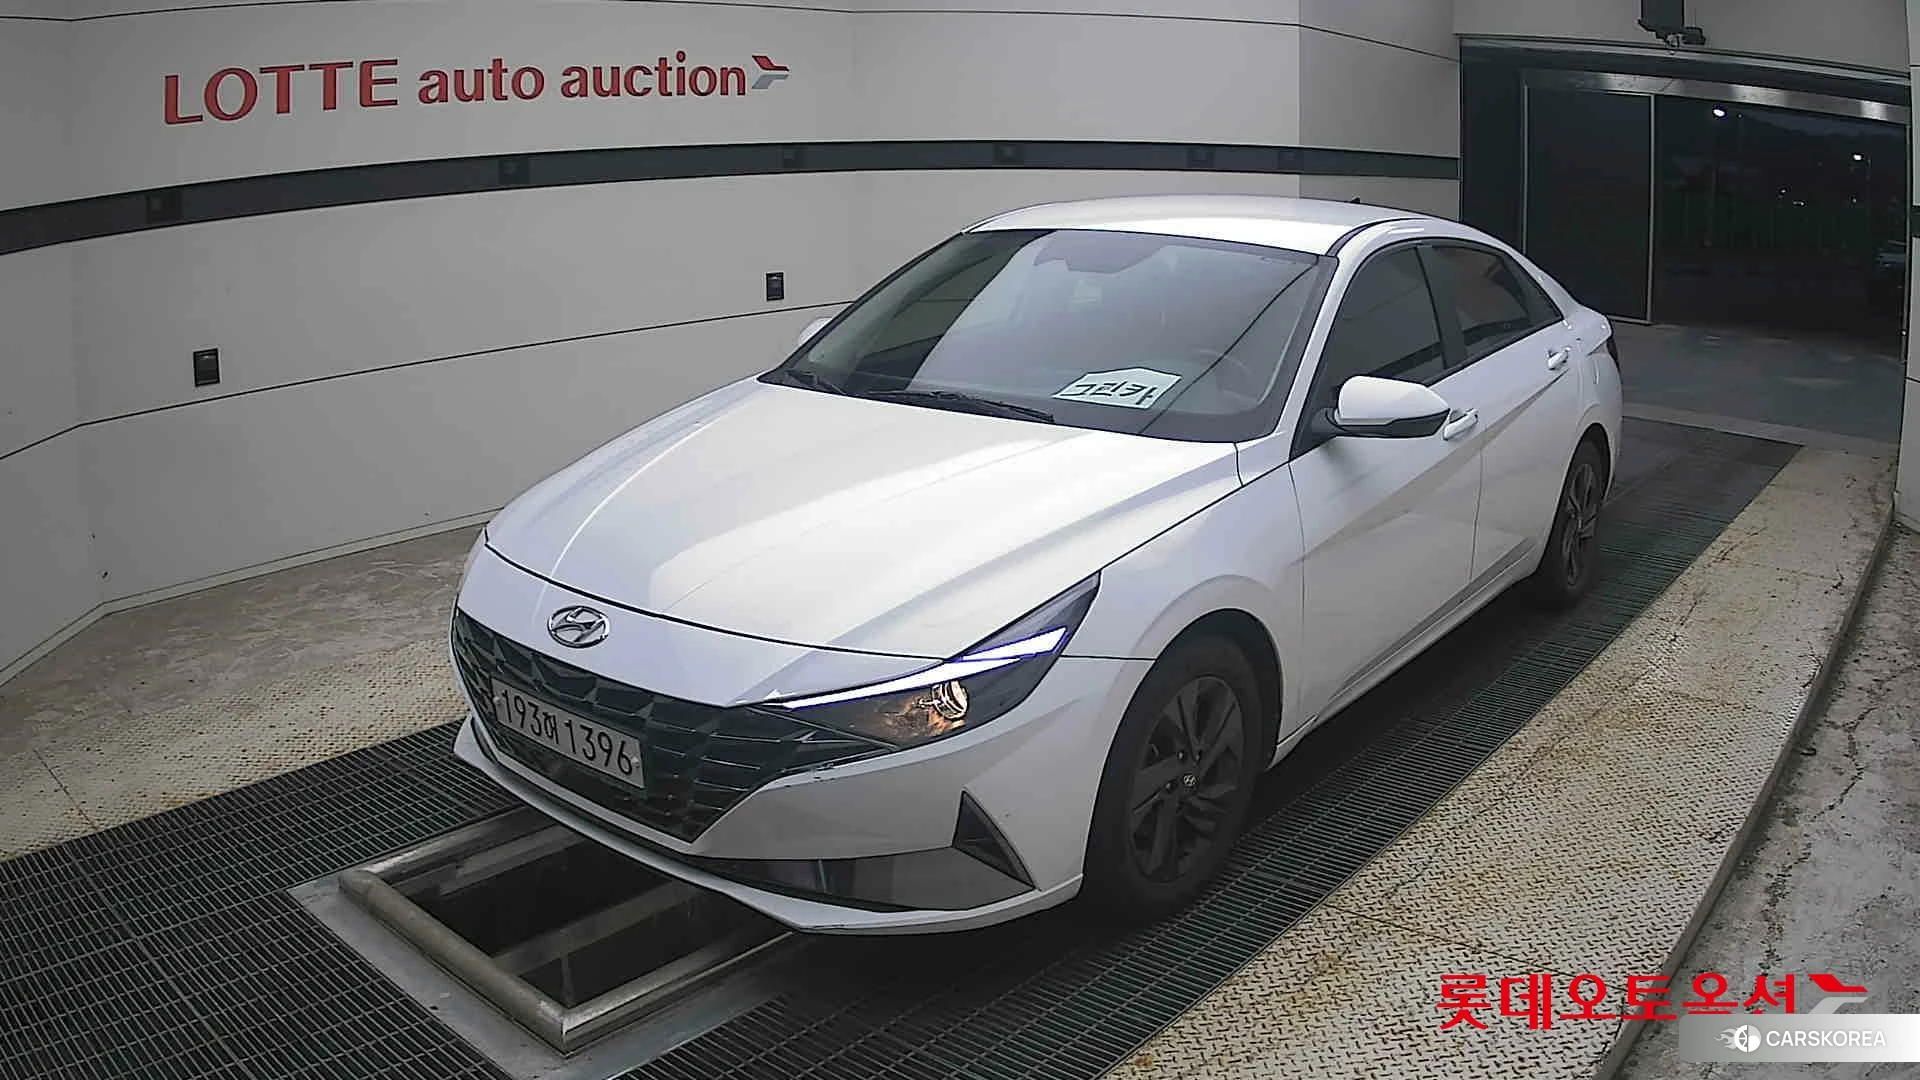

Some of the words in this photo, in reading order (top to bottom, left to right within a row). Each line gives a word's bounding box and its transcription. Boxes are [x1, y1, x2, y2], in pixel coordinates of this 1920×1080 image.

[164, 58, 399, 125] LOTTE
[418, 57, 546, 104] auto
[560, 50, 747, 98] auction
